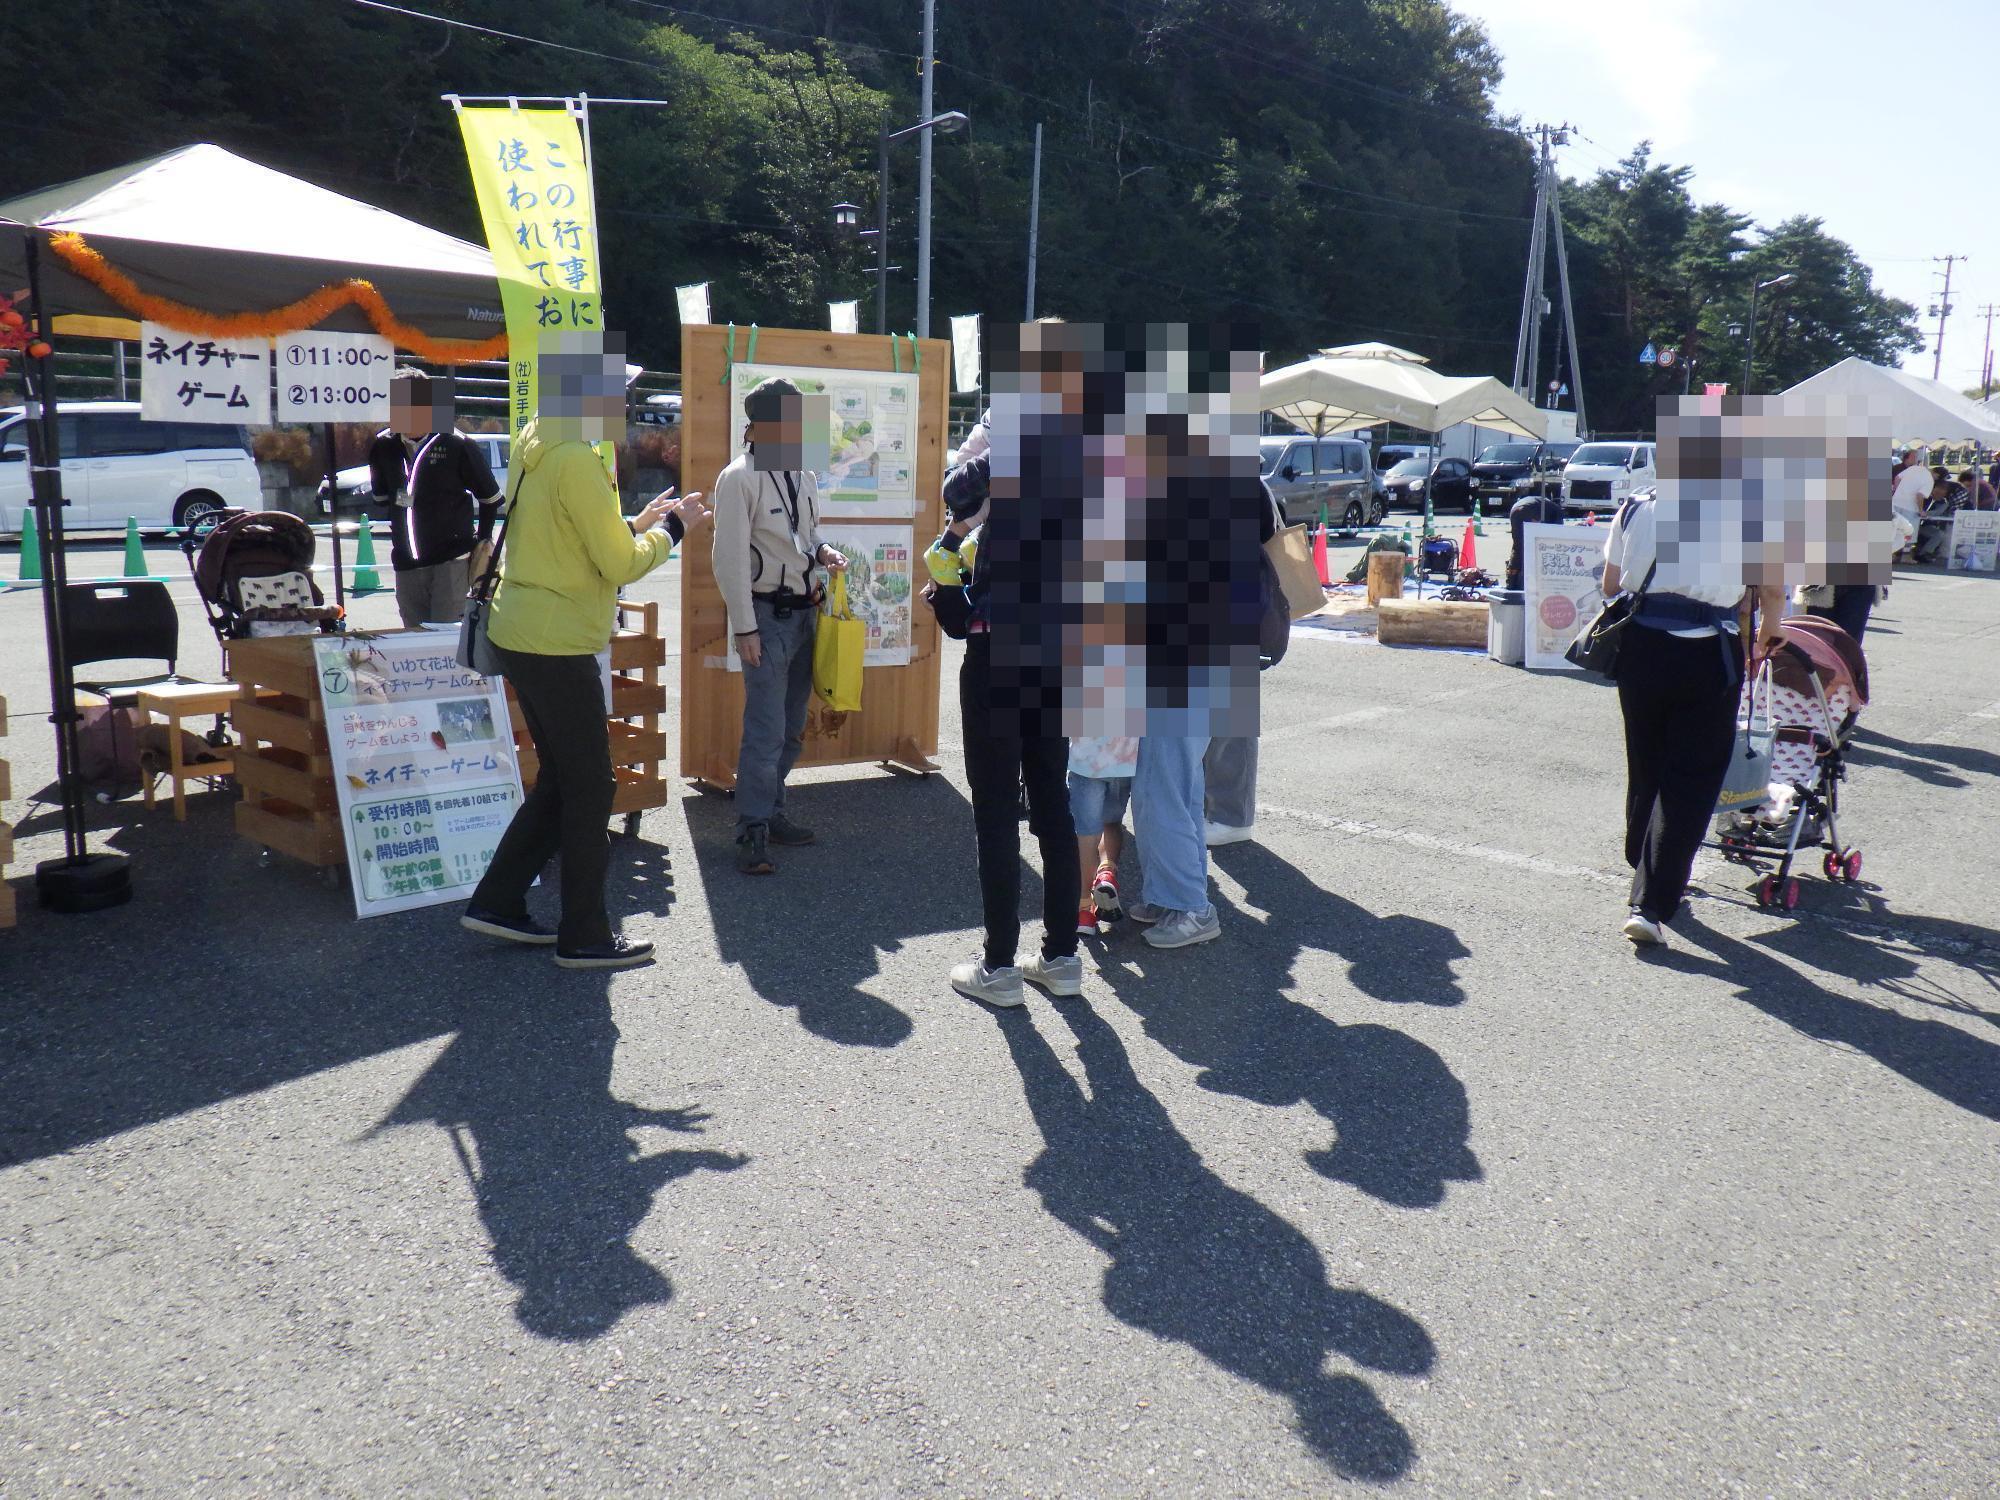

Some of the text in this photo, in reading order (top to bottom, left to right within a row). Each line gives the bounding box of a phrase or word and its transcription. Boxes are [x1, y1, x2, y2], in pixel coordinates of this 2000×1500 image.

[498, 138, 563, 327] 使われてお
[546, 141, 594, 325] この行事に
[146, 336, 260, 369] ネイチャー
[176, 381, 250, 408] ゲーム
[514, 360, 532, 438] (社)岩手県
[392, 656, 457, 674] いわて花北
[364, 755, 498, 785] ネイチャーゲーム
[367, 798, 431, 823] 受付時間
[375, 836, 440, 862] 開始時間
